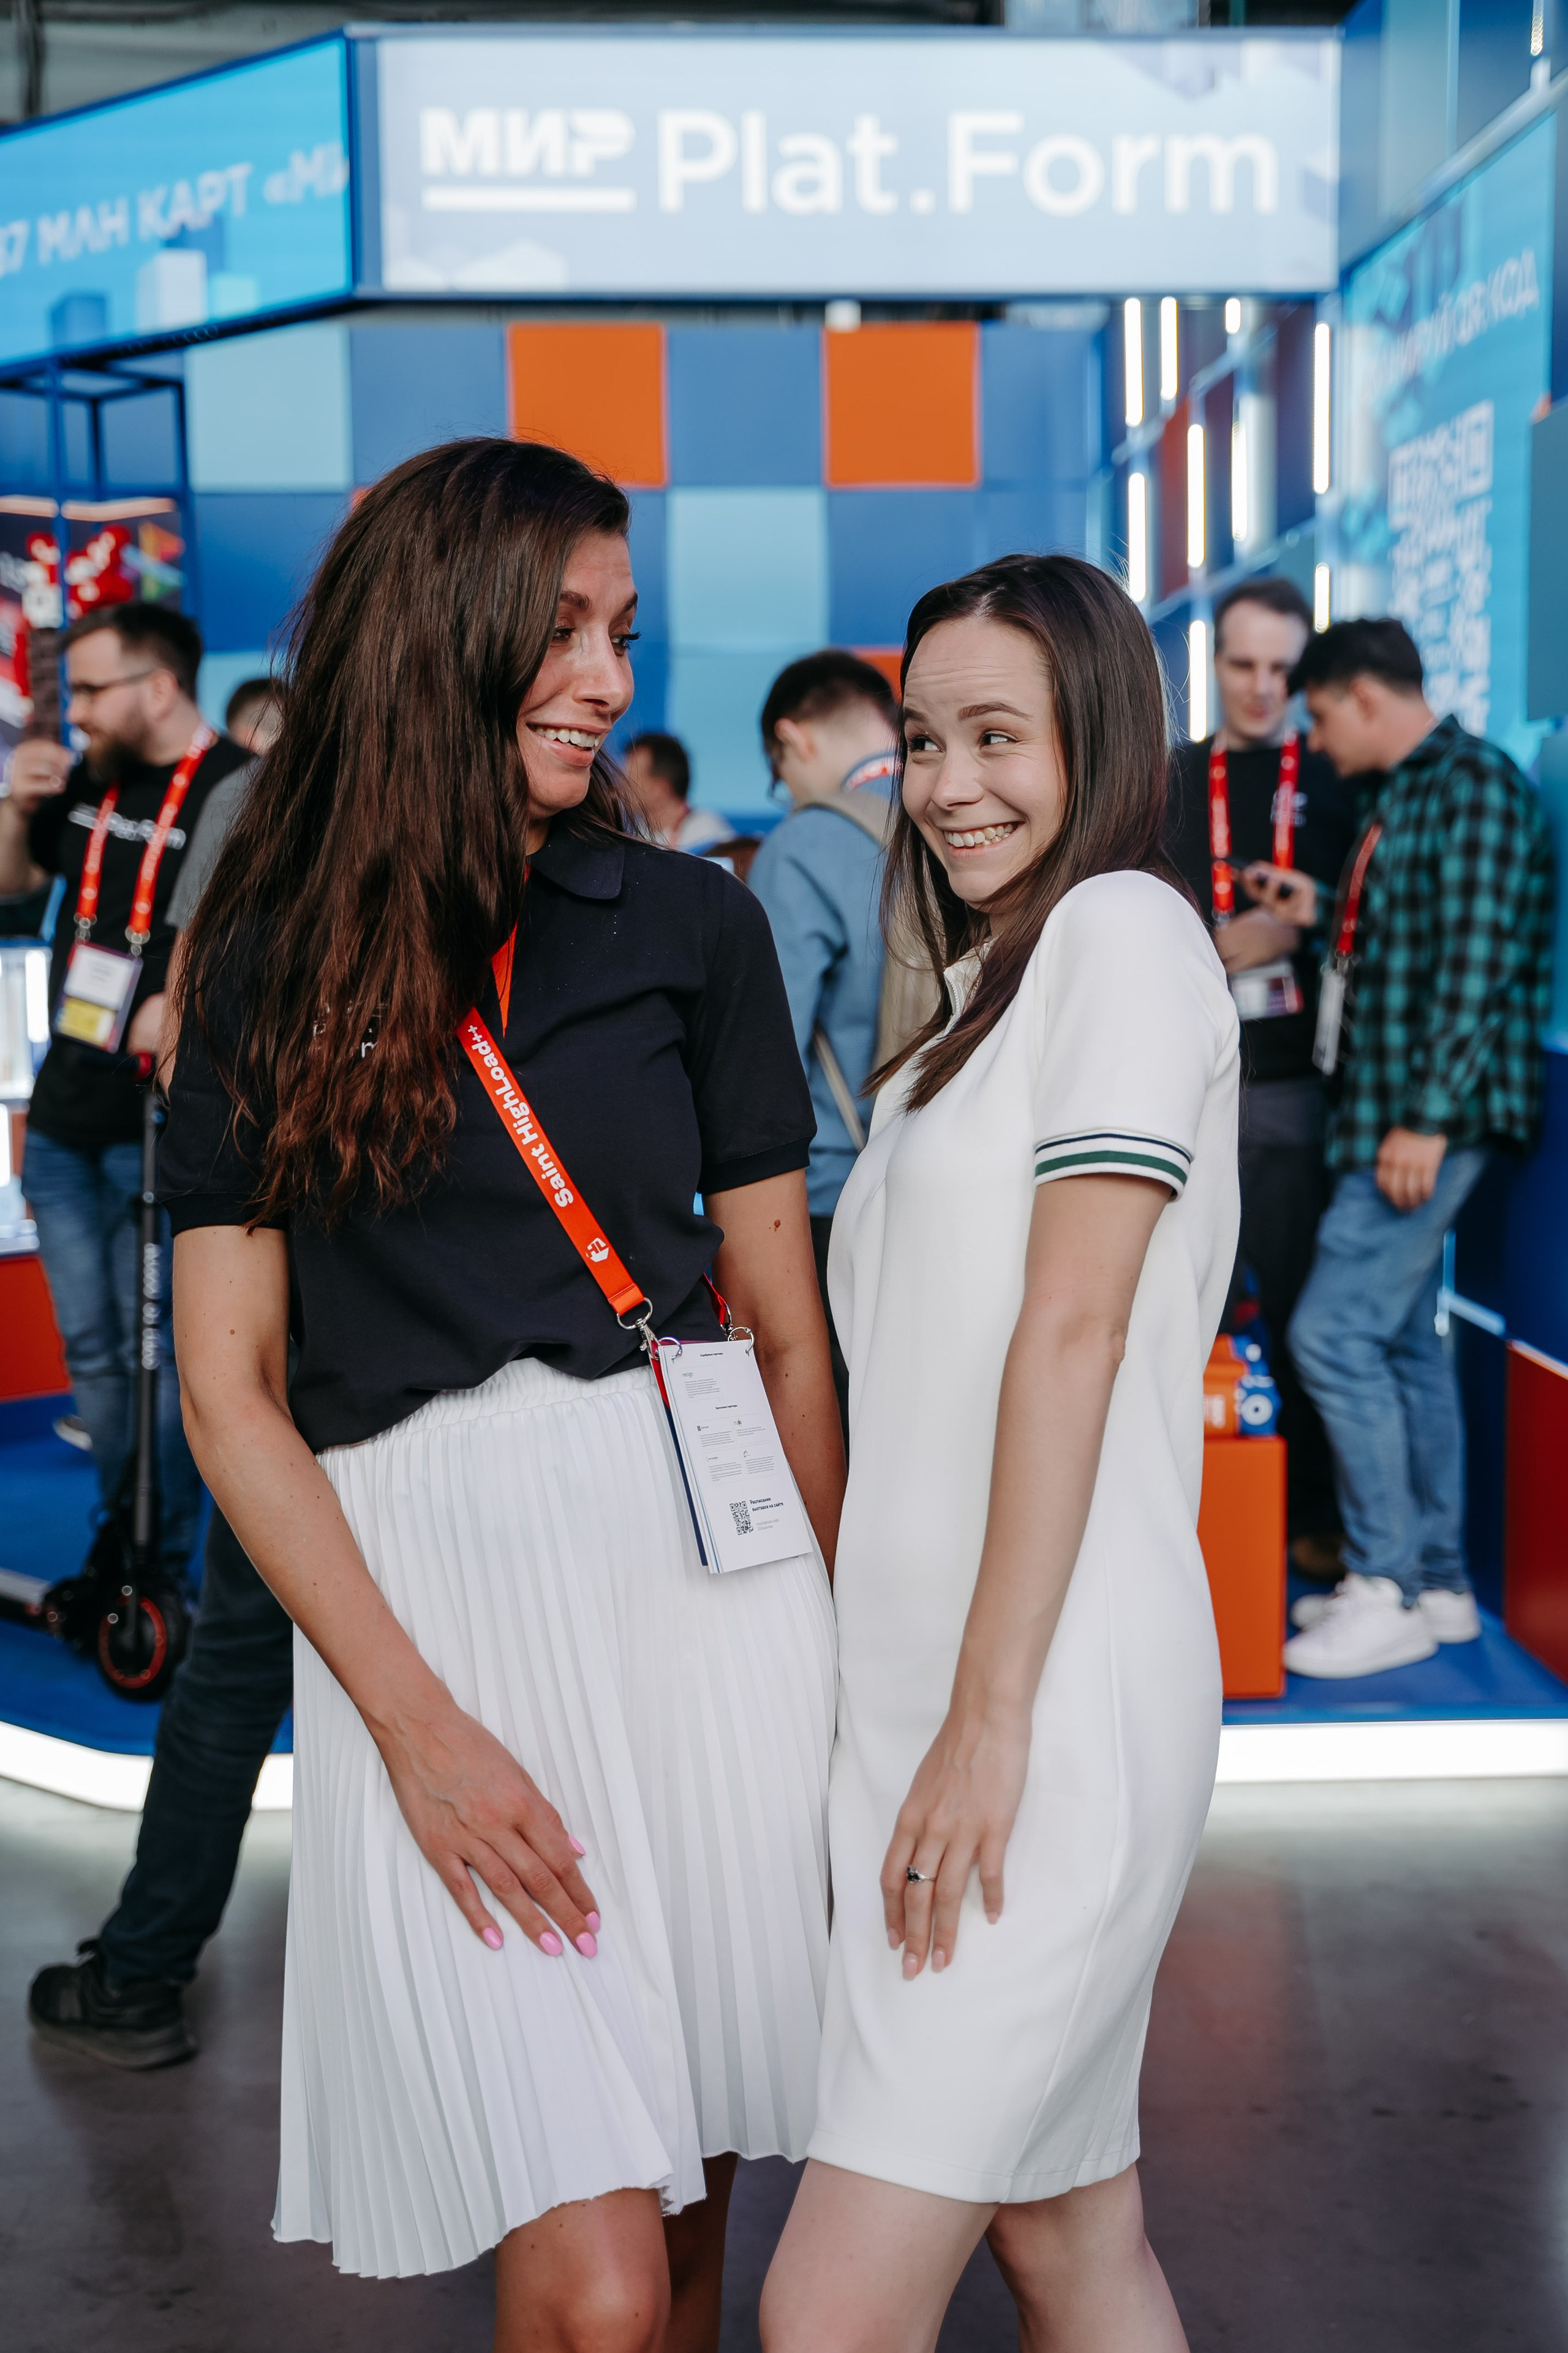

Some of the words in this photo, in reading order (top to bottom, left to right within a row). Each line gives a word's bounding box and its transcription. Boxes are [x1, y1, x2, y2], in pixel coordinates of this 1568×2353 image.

[137, 162, 253, 243] КАРТ
[657, 109, 1279, 216] Plat.Form
[467, 1024, 538, 1146] HighLoad++
[531, 1143, 574, 1207] Saint
